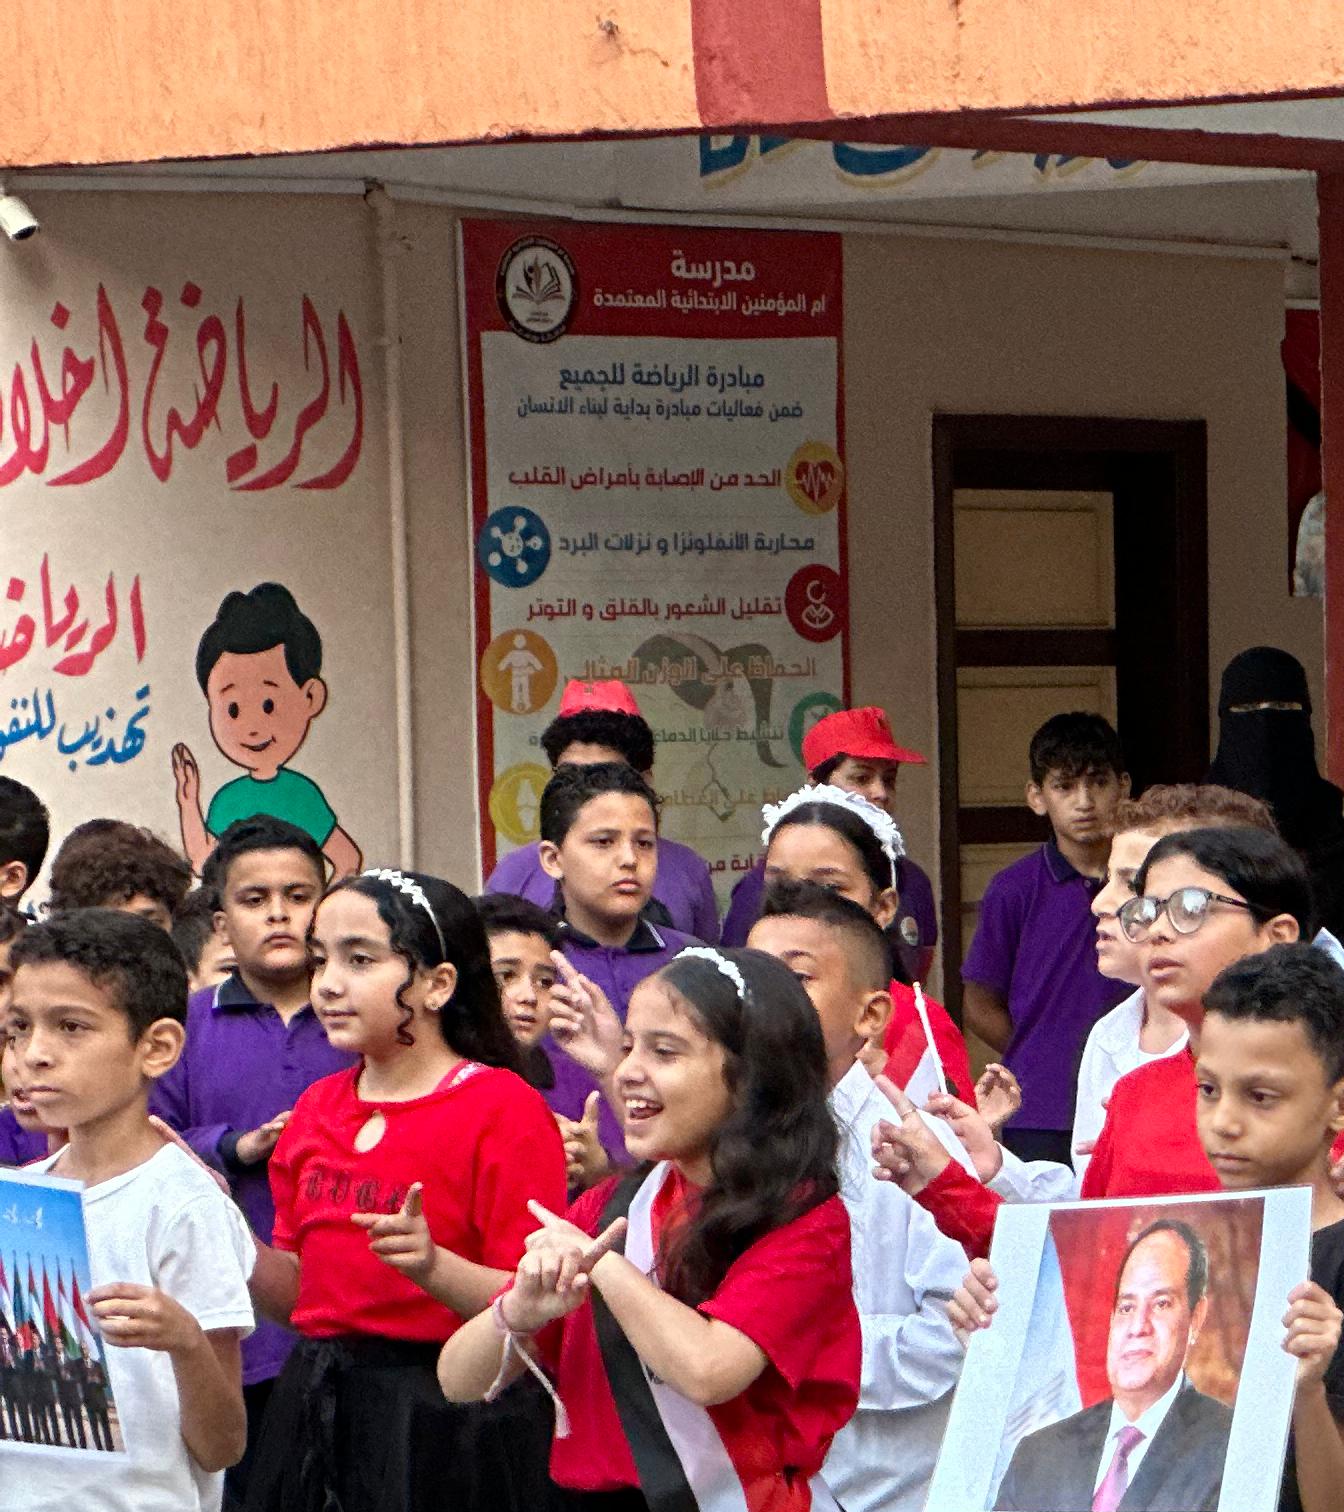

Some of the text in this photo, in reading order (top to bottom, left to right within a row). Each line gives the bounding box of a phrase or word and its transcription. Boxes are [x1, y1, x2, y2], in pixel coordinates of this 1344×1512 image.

[671, 248, 756, 288] مدرسة
[593, 287, 826, 317] ام المؤمنين الابتدائية المعتمدة
[559, 362, 765, 393] مبادرة الرياضة للجميع
[613, 397, 650, 421] بداية
[656, 397, 701, 421] مبادرة
[707, 398, 763, 422] فعاليات
[769, 398, 803, 422] ضمن
[508, 465, 566, 487] القلب
[570, 462, 641, 491] بأمراض
[710, 472, 739, 491] من
[743, 468, 782, 488] الحد
[559, 531, 598, 556] البرد
[605, 532, 652, 556] نزلات
[656, 539, 668, 557] و
[755, 533, 815, 556] محاربة
[526, 594, 783, 622] تقليل الشعور بالقلق و التوتر
[57, 683, 151, 773] تهذيب
